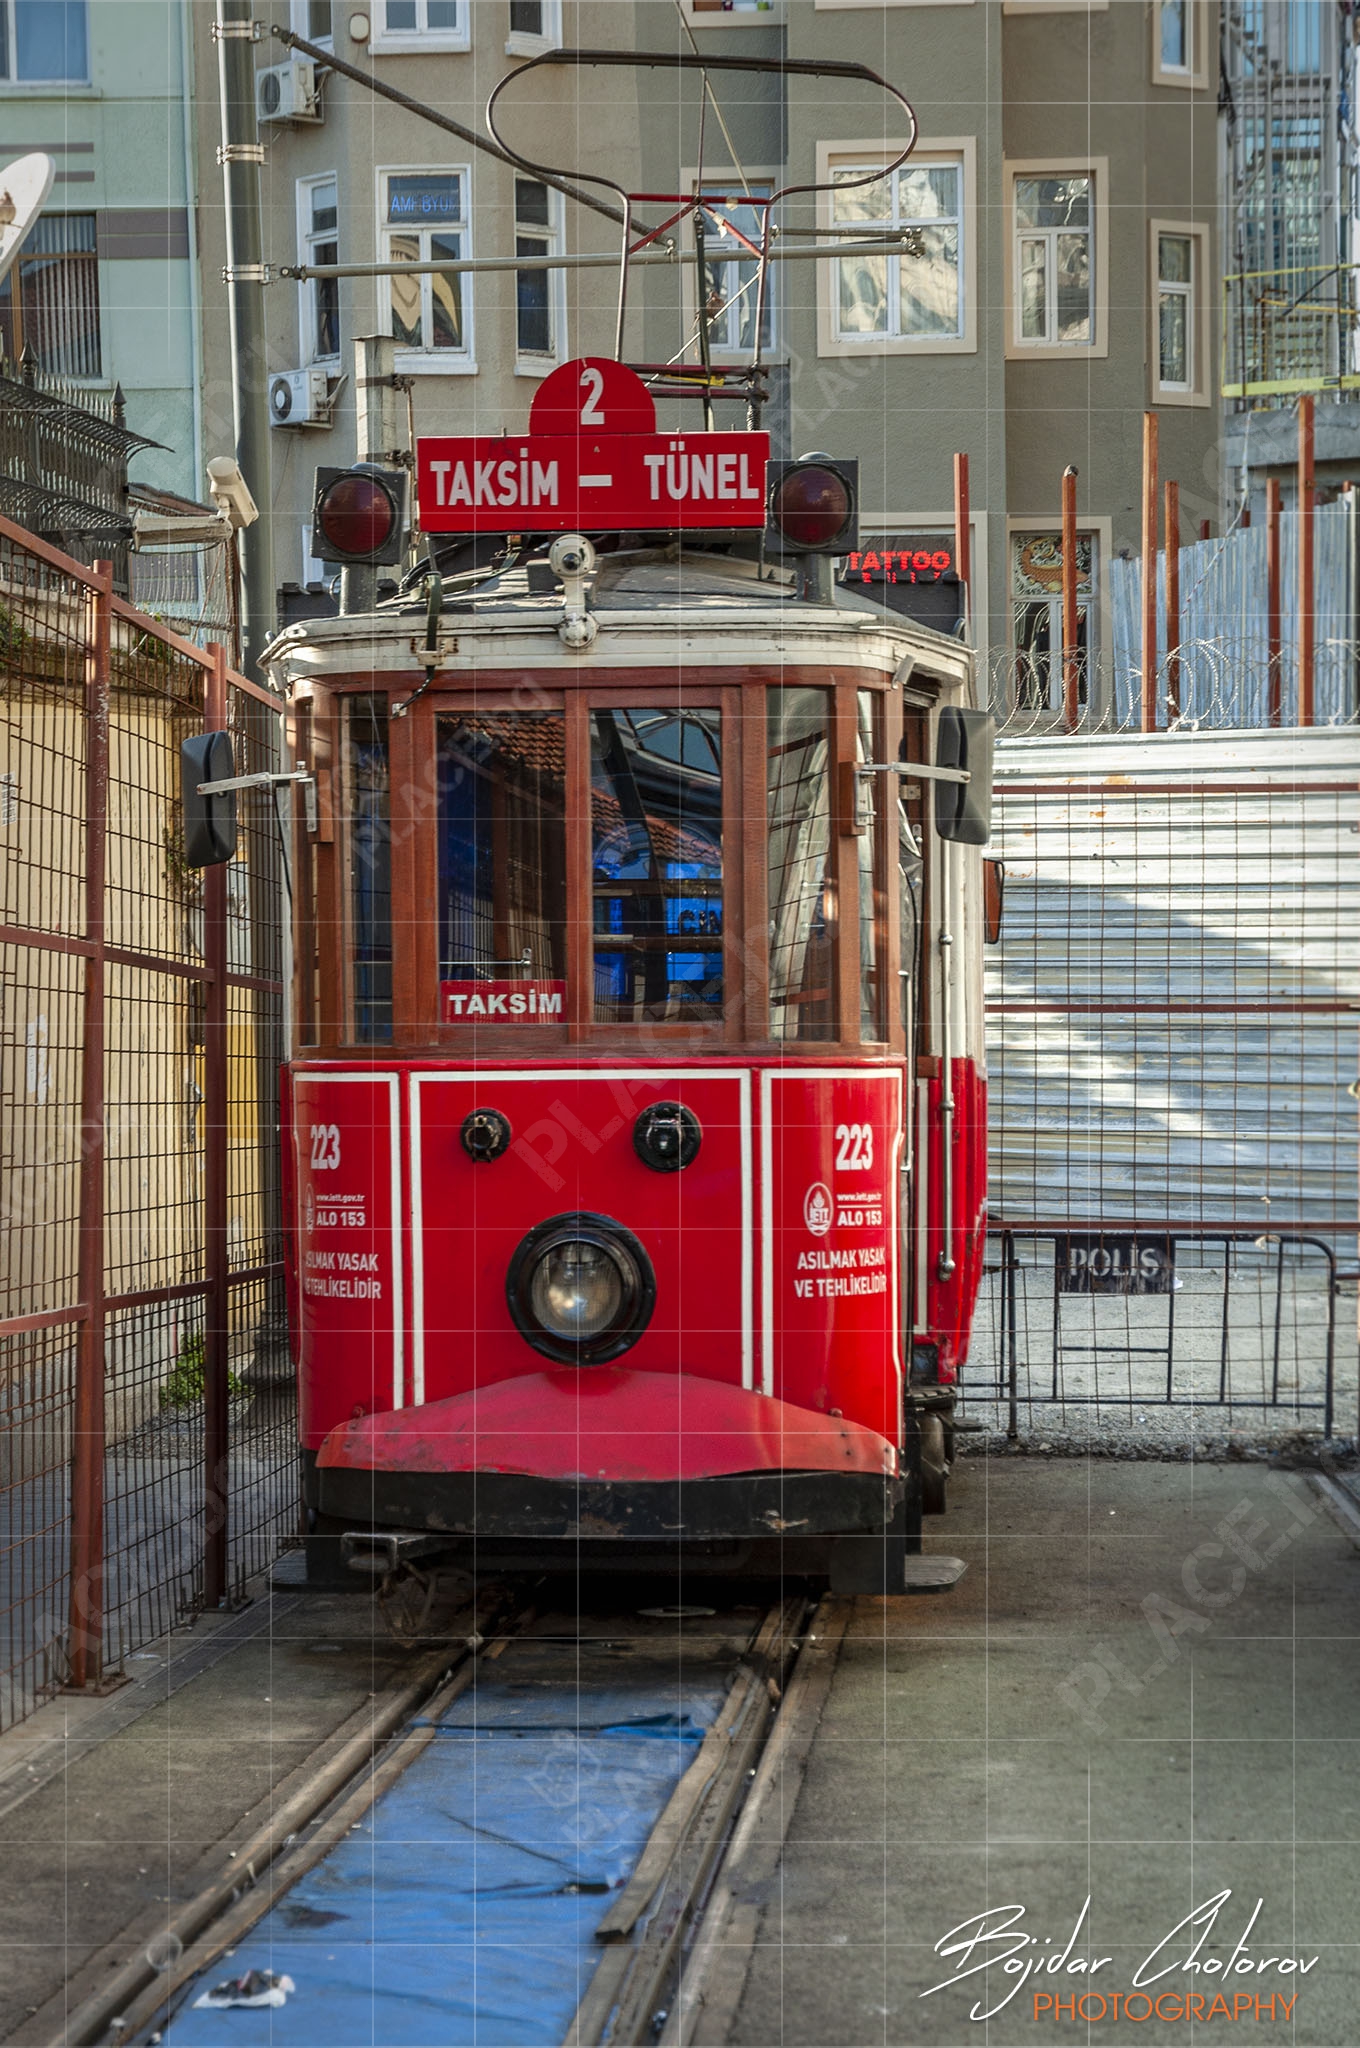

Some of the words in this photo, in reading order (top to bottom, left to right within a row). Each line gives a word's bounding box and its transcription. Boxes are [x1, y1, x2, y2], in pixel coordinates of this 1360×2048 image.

[579, 367, 605, 425] 2
[429, 447, 559, 506] TAKSİM
[643, 441, 760, 501] TÜNEL
[848, 550, 951, 571] TATTOO
[448, 988, 562, 1015] TAKSİM
[310, 1123, 341, 1171] 223
[835, 1123, 873, 1171] 223
[316, 1211, 338, 1226] ALO
[340, 1211, 366, 1227] 153
[837, 1210, 863, 1227] ALO
[865, 1210, 882, 1226] 153
[336, 1252, 379, 1272] YASAK
[796, 1249, 858, 1271] ASILMAK
[858, 1247, 886, 1267] YASAK
[1070, 1242, 1160, 1279] POLİS
[793, 1279, 815, 1298] VE
[815, 1270, 887, 1298] TEHLİKELİDİR
